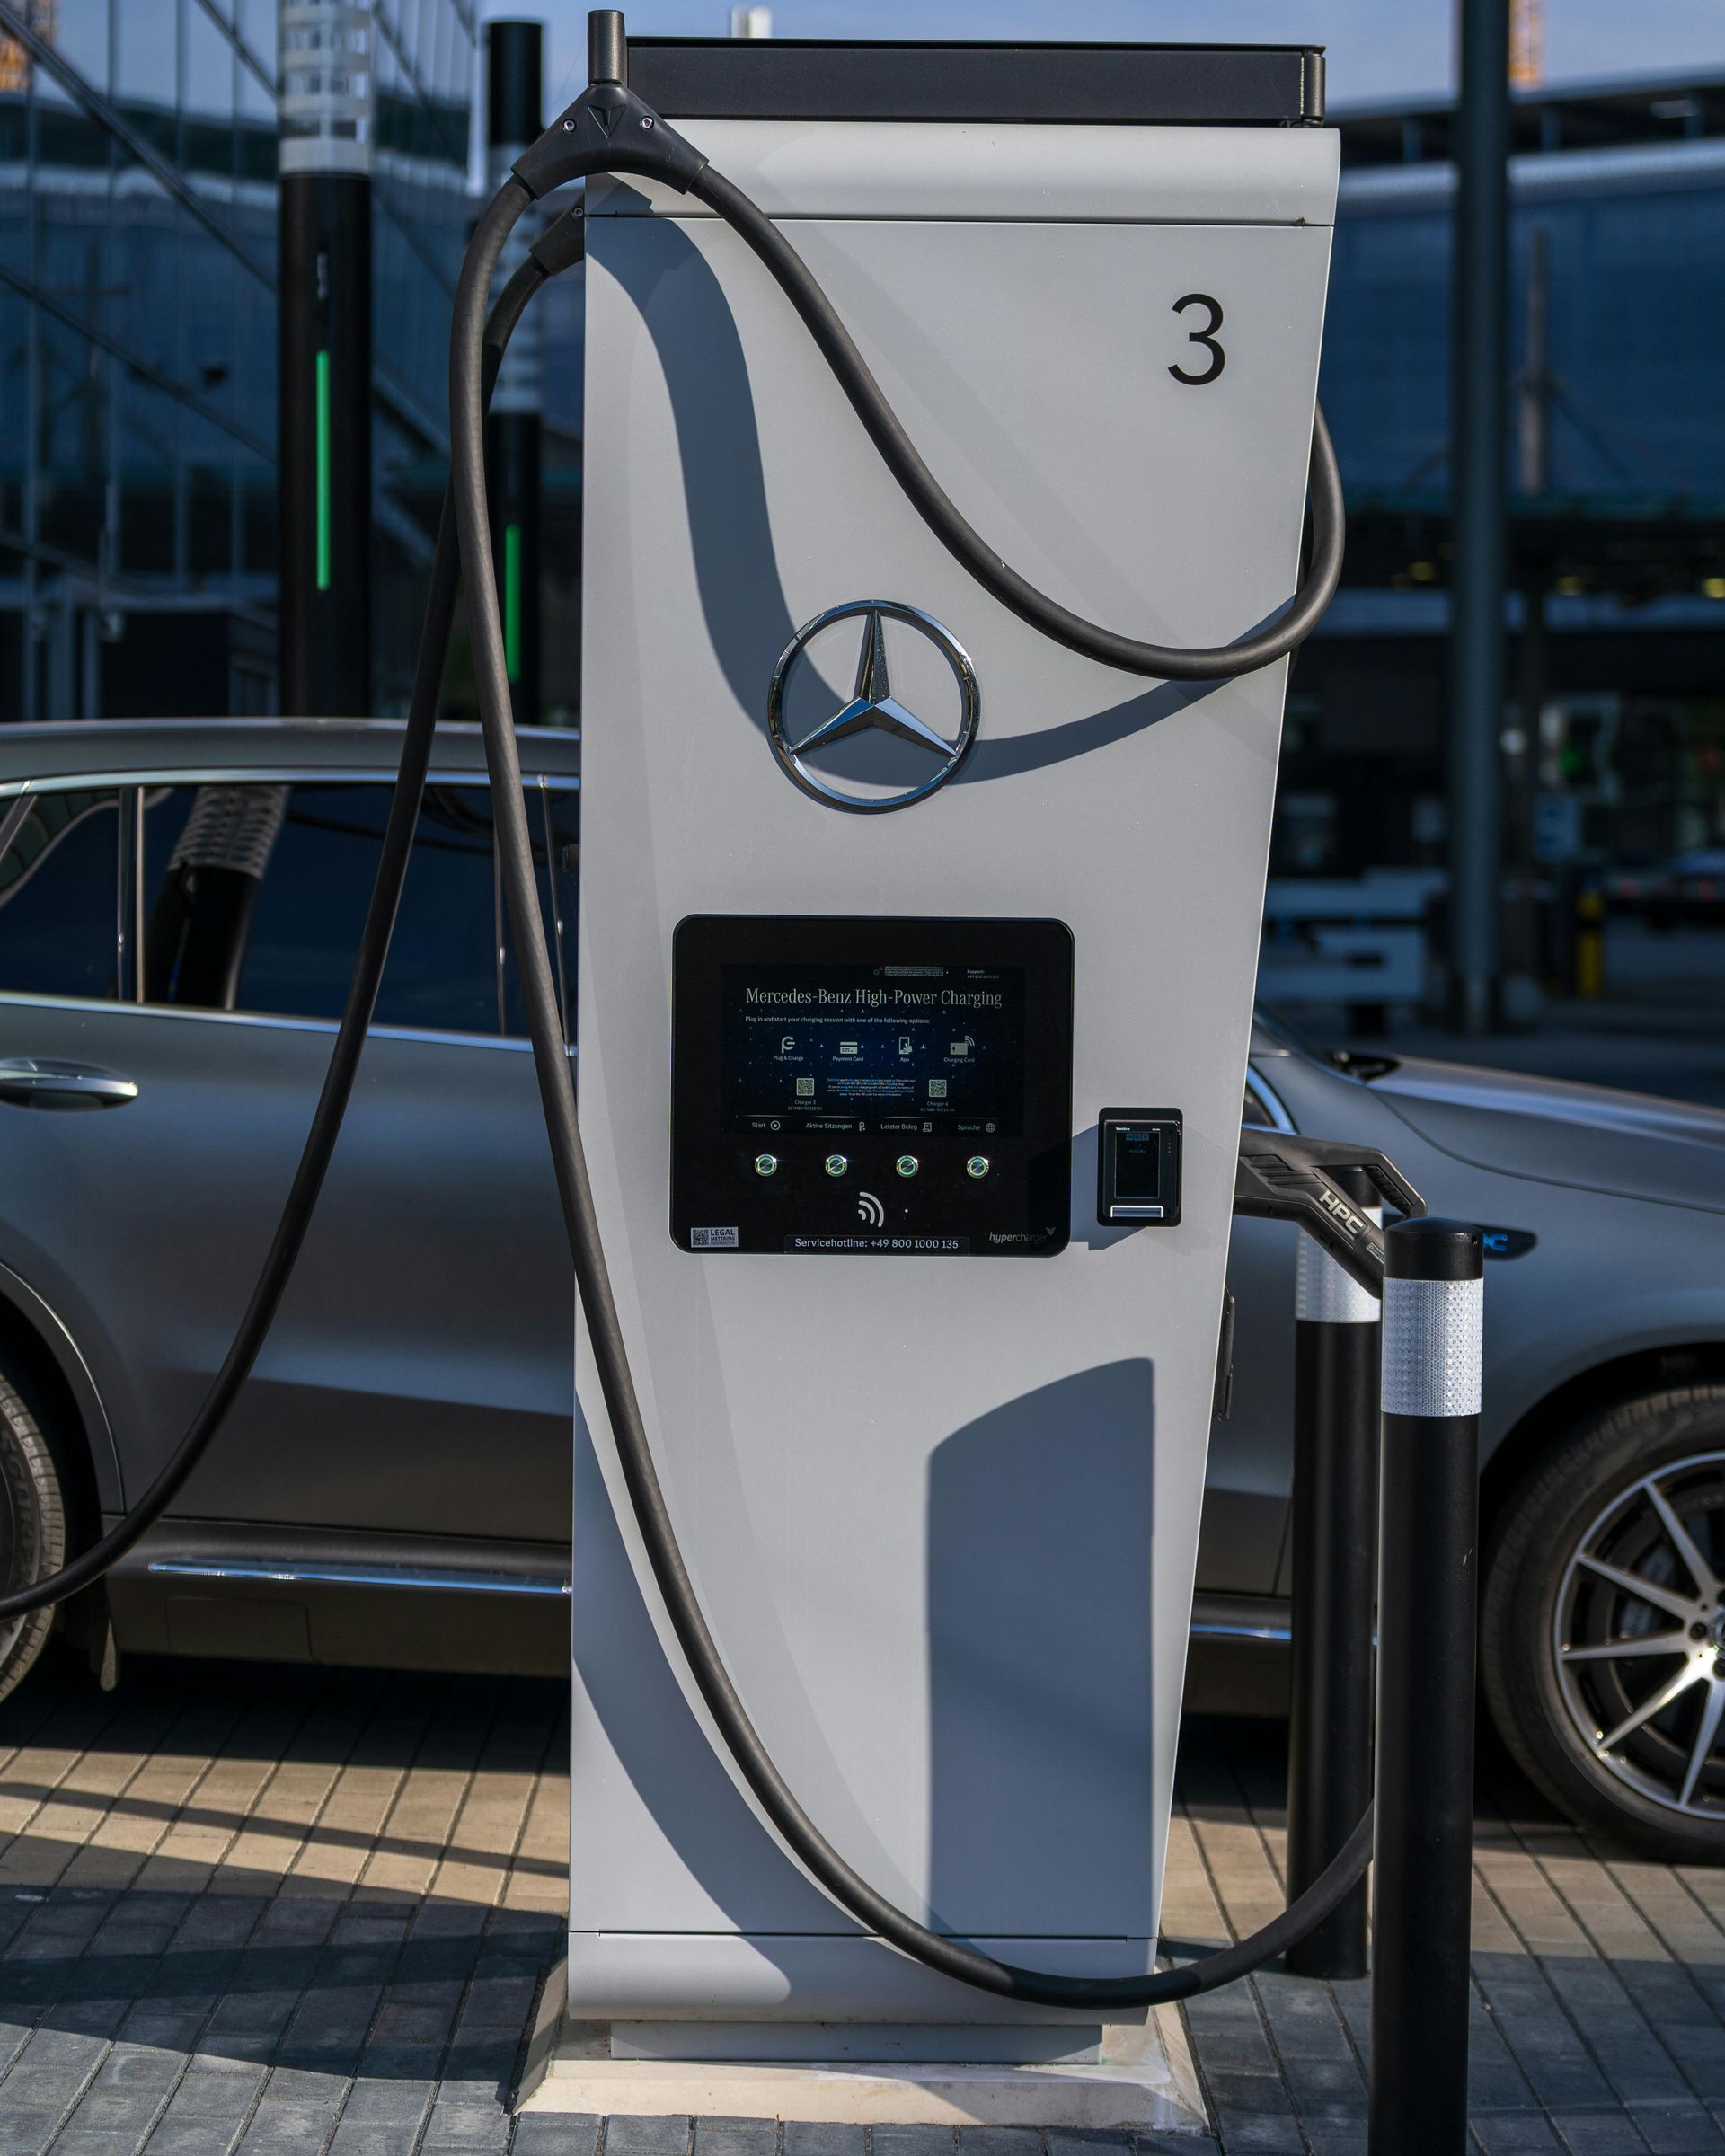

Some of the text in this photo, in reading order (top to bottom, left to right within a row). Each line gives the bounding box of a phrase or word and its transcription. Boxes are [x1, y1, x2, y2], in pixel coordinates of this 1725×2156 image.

[1168, 293, 1225, 385] 3
[746, 987, 1003, 1009] Mercedes-Benz High-Power Charging
[745, 1015, 757, 1023] Plug
[801, 1016, 823, 1024] charging
[824, 1122, 853, 1130] Sitzungen
[901, 1123, 918, 1131] Beleg
[957, 1123, 981, 1131] Sprache
[1318, 1190, 1364, 1234] HPC
[710, 1228, 736, 1236] LEGAL
[794, 1238, 959, 1249] Servicehotline: +49 800 1000 135
